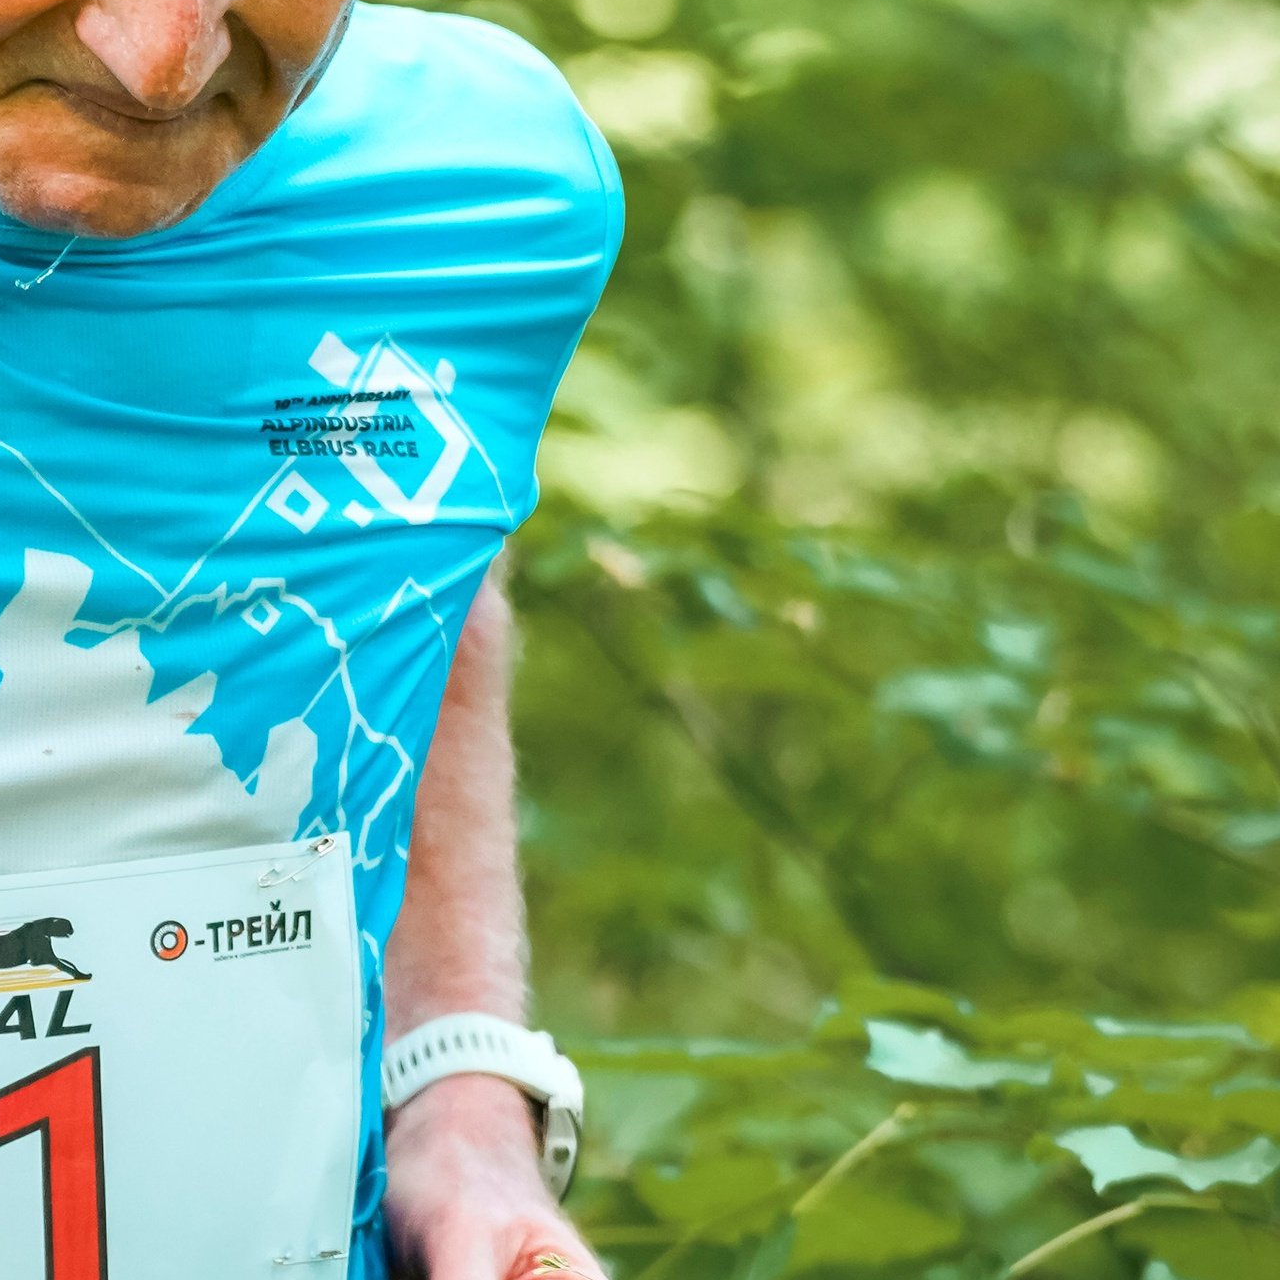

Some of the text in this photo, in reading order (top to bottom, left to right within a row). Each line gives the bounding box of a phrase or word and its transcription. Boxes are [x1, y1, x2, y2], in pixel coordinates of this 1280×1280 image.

[307, 390, 411, 406] ANNIVERSARY
[260, 415, 415, 432] ALPINDUSTRIA
[269, 439, 419, 458] ELBRUS RACE
